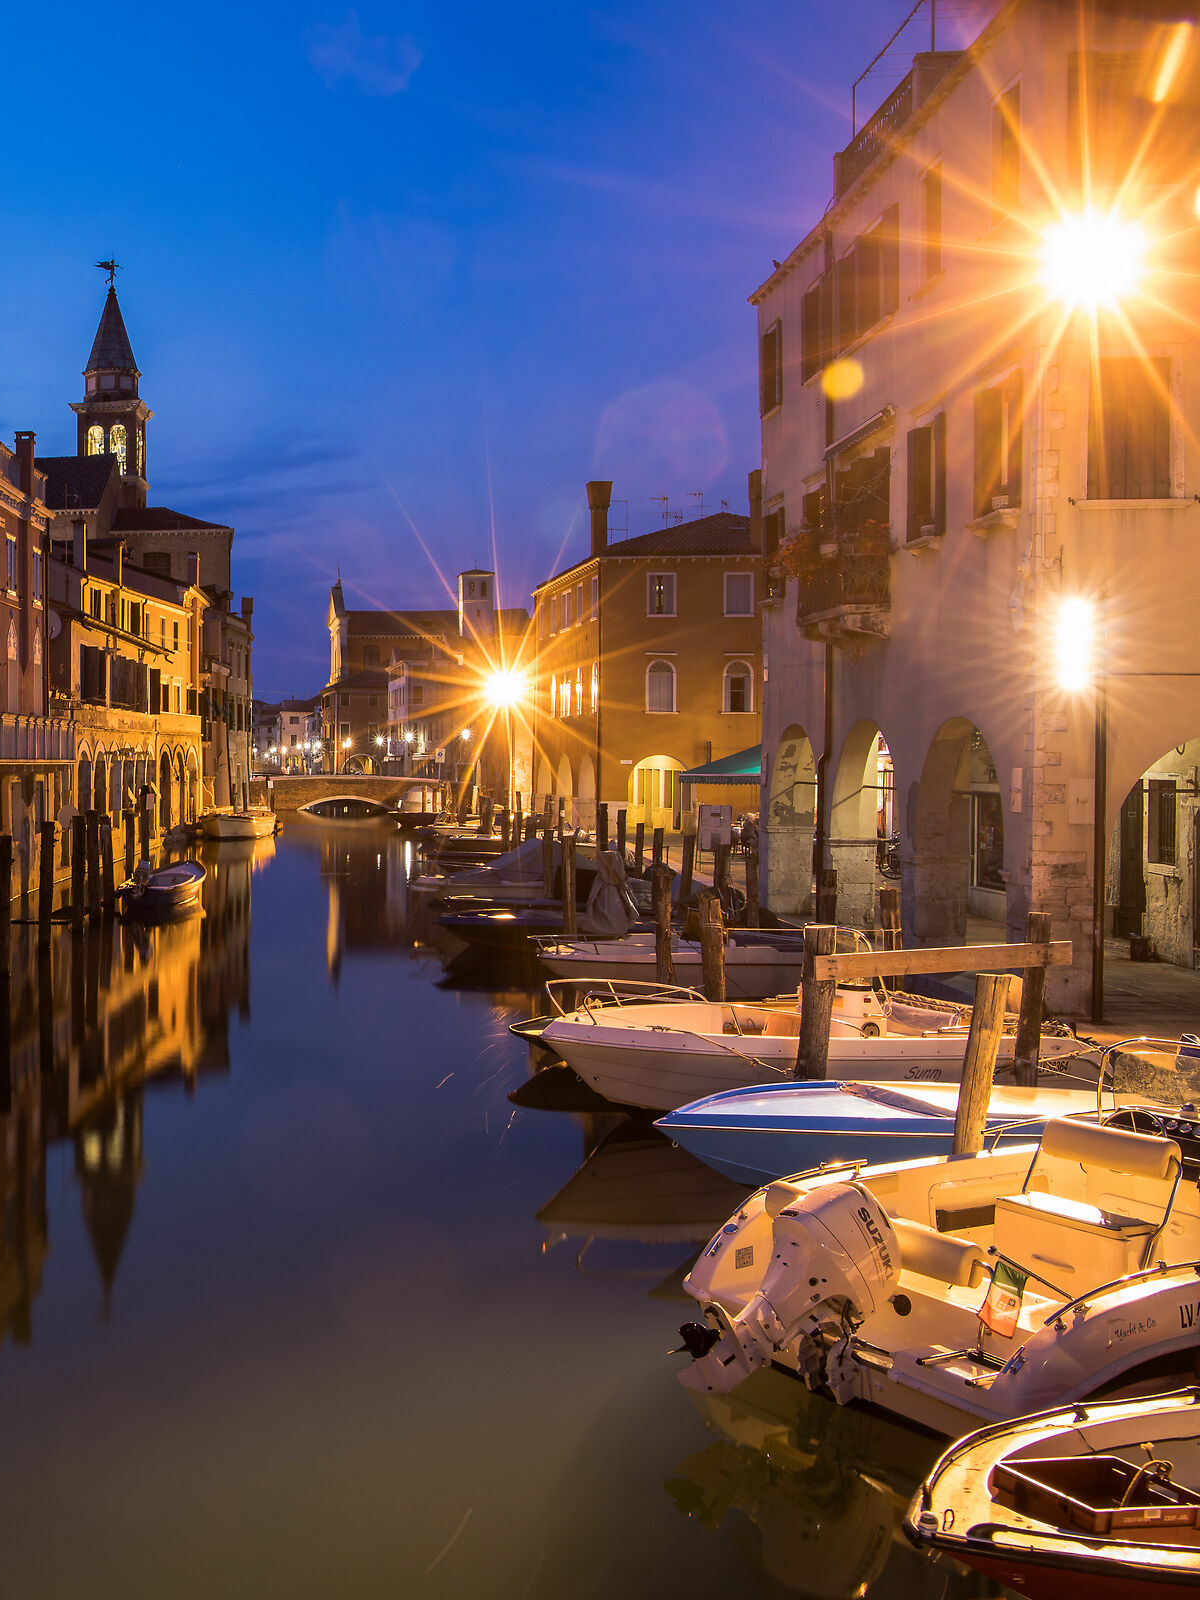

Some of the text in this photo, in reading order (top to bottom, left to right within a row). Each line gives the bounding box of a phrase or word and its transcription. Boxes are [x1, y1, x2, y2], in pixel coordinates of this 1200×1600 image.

[857, 1206, 894, 1280] SUZUKI
[1114, 1322, 1137, 1341] Yacht
[1138, 1322, 1146, 1333] &
